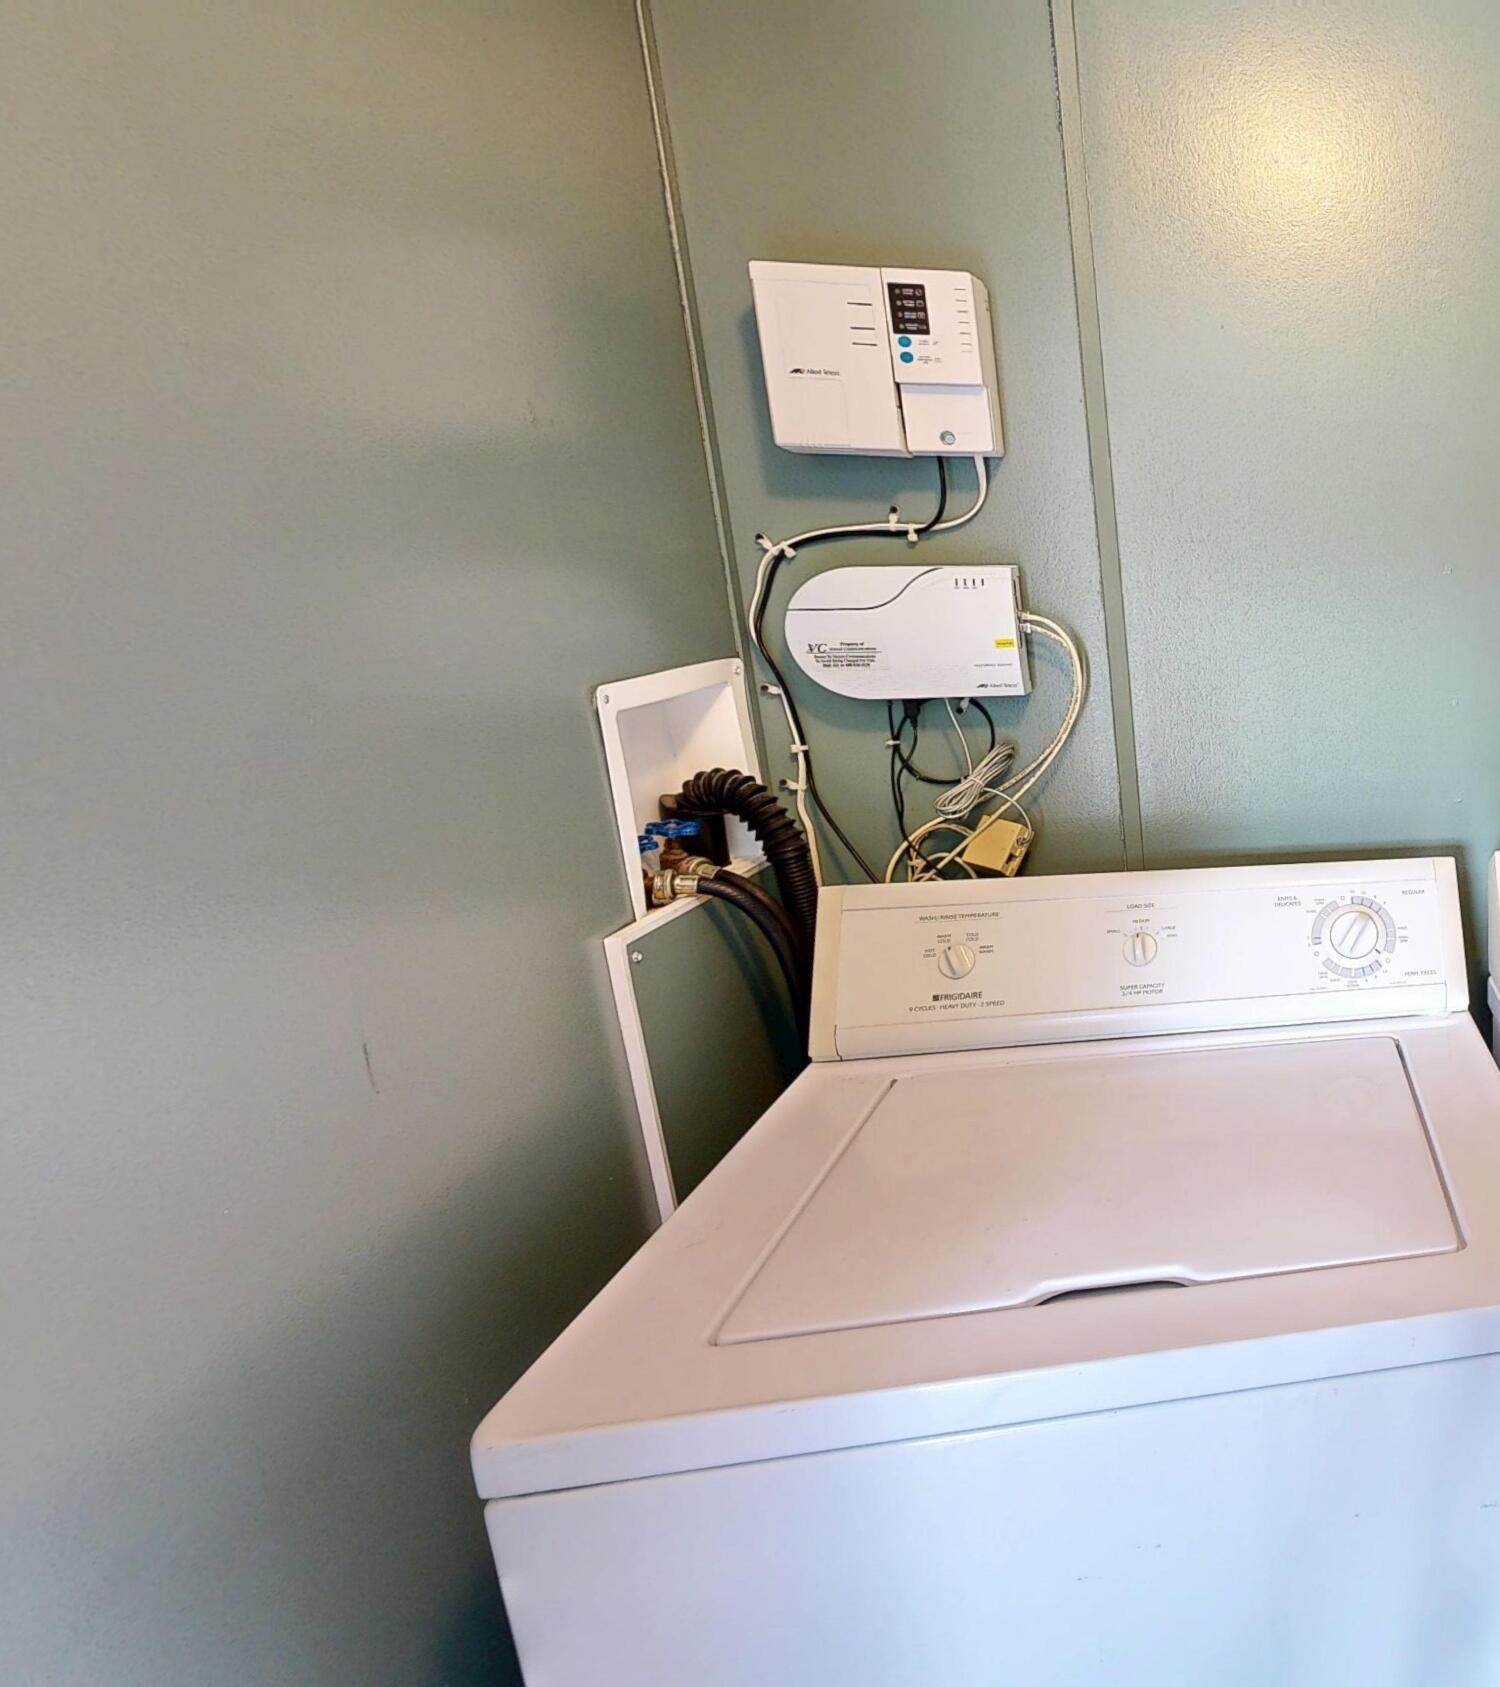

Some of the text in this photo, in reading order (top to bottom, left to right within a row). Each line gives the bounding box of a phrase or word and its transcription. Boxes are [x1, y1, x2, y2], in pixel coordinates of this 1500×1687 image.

[959, 911, 1000, 919] TEMPERATURE
[1138, 982, 1166, 990] CAPACITY
[940, 991, 983, 1001] FRIGIDAIRE
[914, 1004, 936, 1012] CYCLES
[939, 1002, 960, 1010] HEAVY
